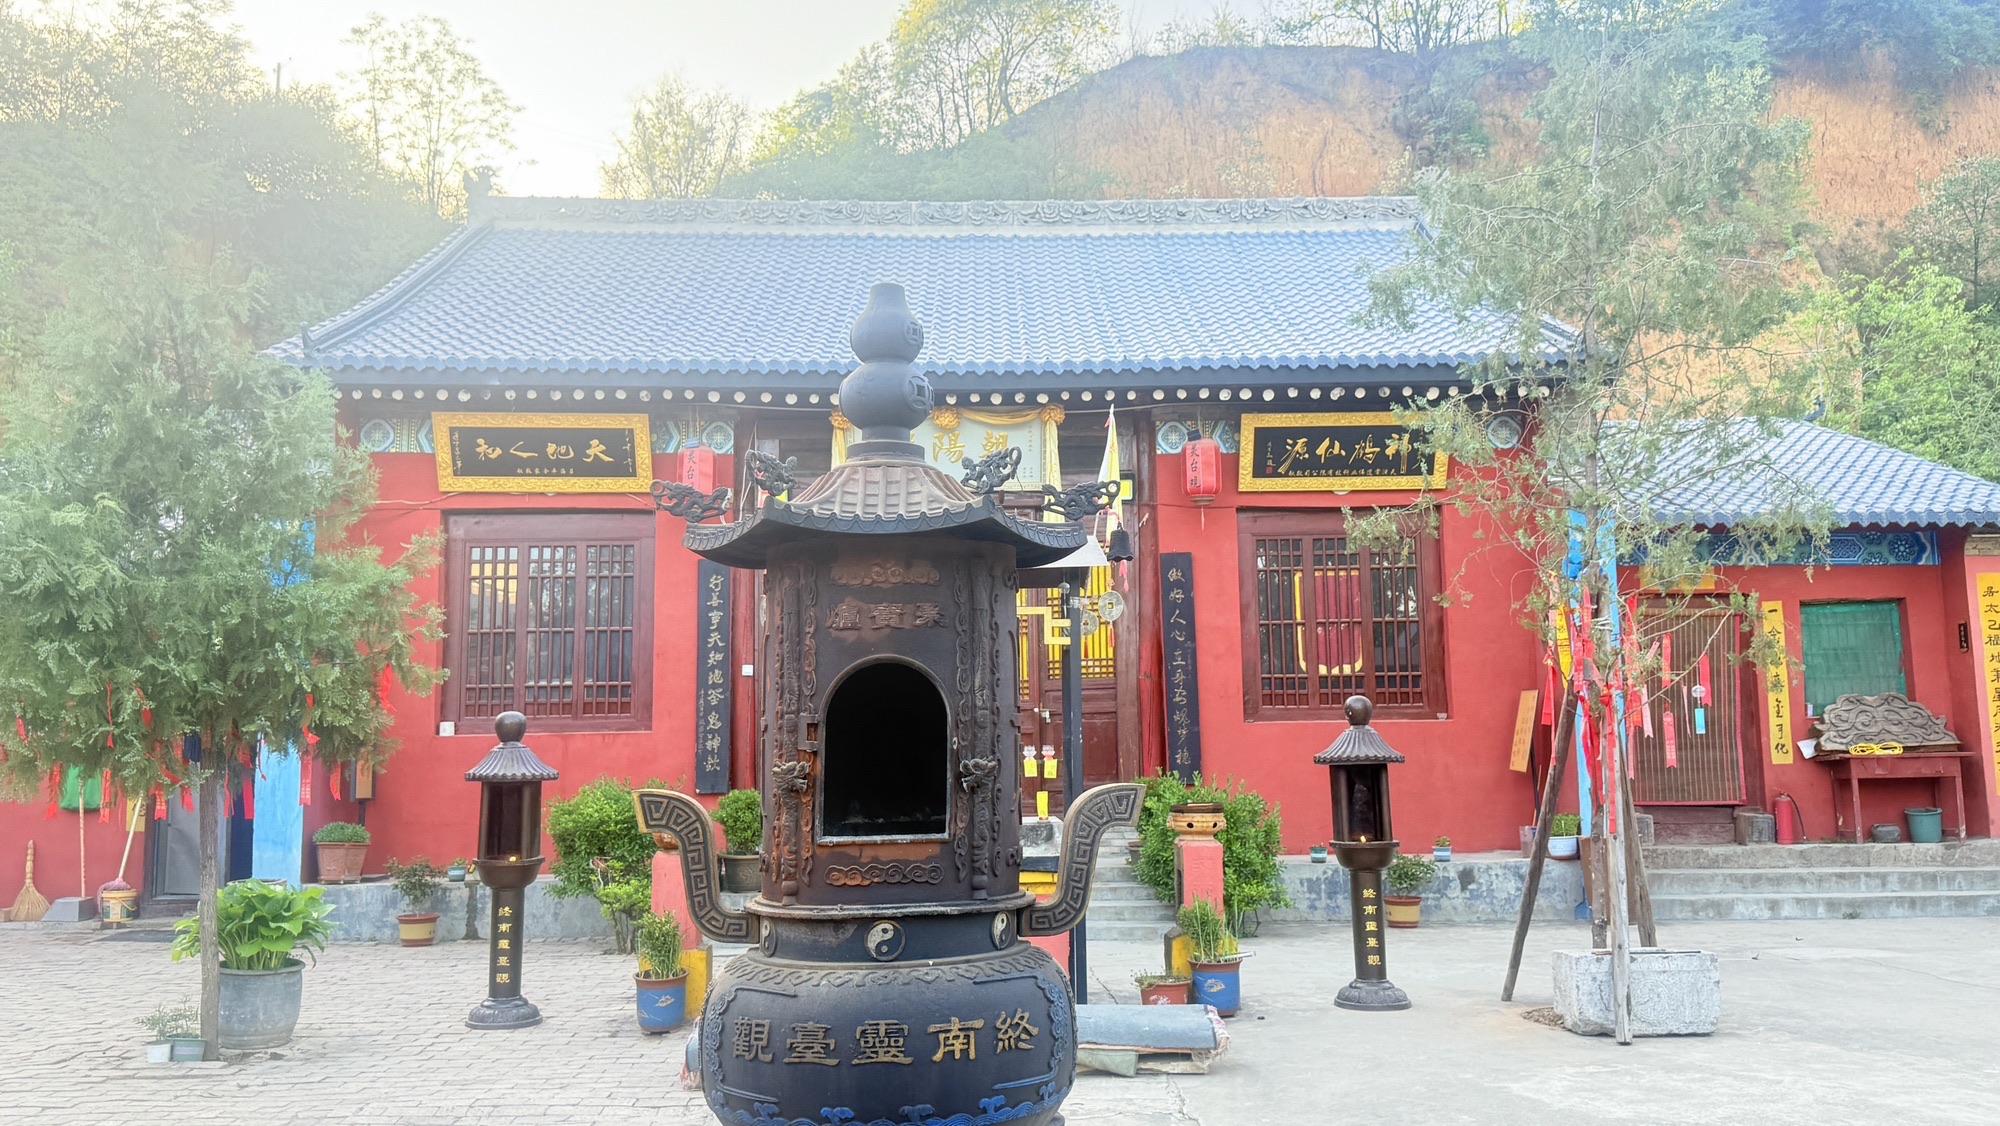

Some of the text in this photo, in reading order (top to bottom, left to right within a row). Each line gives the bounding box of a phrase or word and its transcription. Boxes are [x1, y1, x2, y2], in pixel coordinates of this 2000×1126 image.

[910, 429, 1009, 464] 朝陽
[687, 449, 697, 488] 灵台
[731, 1007, 1040, 1066] 終南靈臺觀
